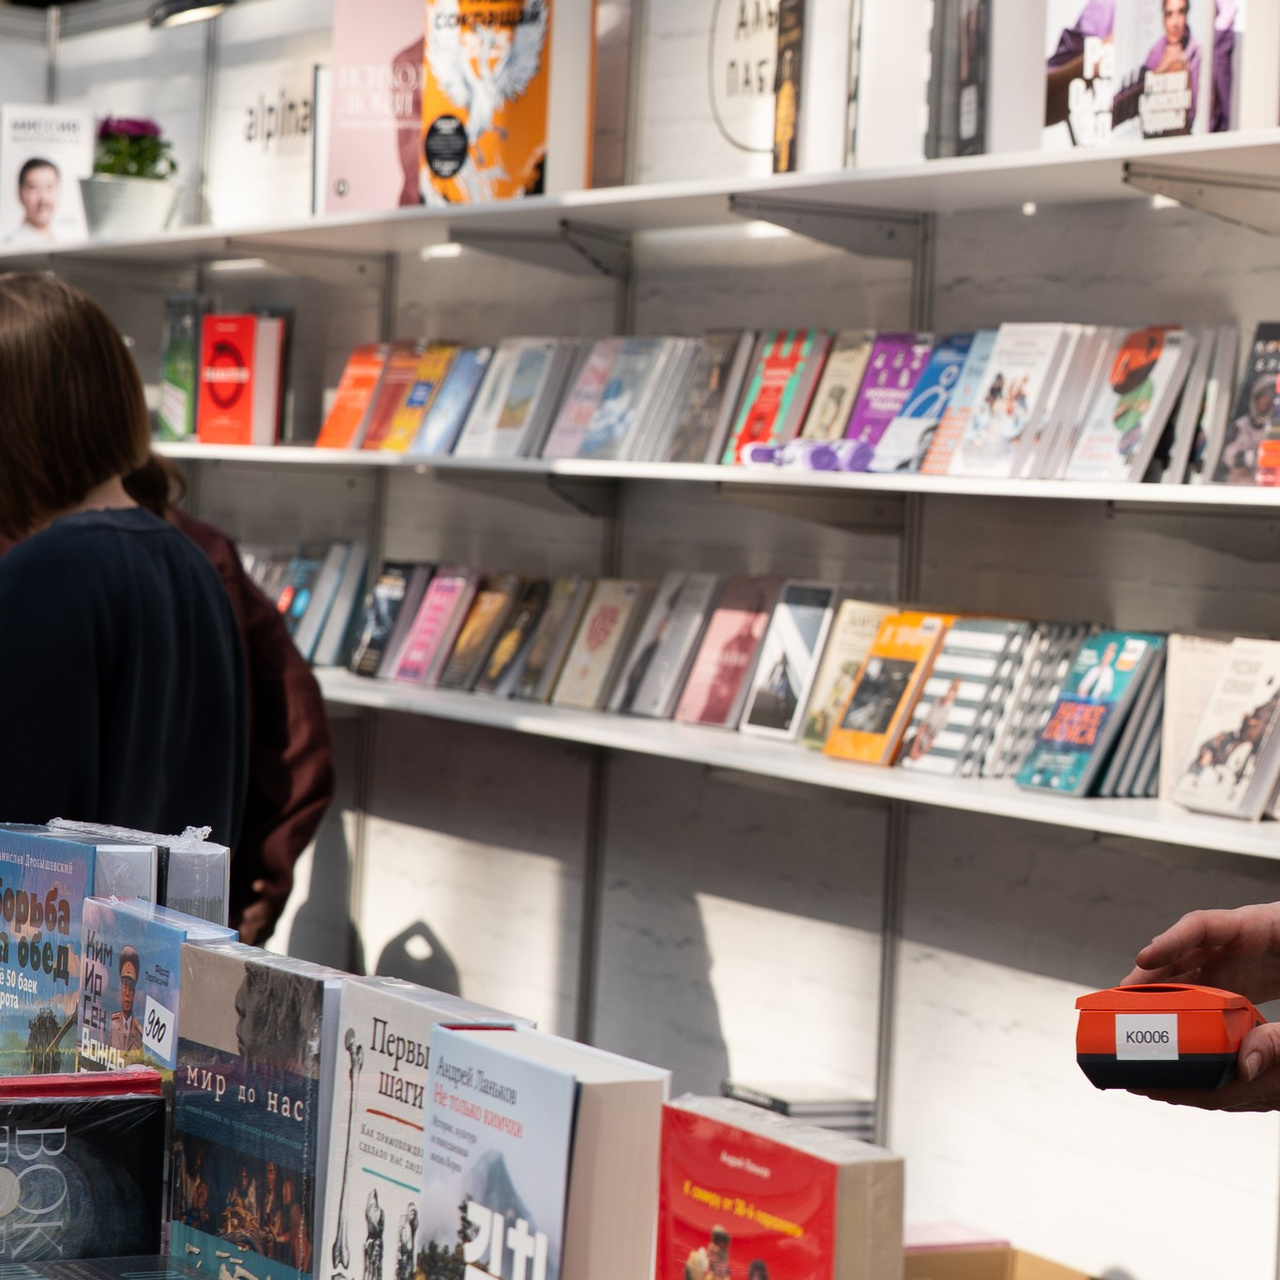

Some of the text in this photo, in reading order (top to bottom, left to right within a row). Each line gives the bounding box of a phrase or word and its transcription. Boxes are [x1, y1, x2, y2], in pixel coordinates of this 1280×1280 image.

[0, 877, 70, 936] орьба
[18, 931, 70, 986] обед
[86, 929, 113, 968] Ким
[7, 970, 38, 995] 50 баек
[84, 962, 103, 1004] Ир
[82, 995, 107, 1032] Сен
[1126, 1030, 1169, 1045] K0006
[186, 1065, 304, 1122] мир до нас
[378, 1071, 425, 1109] шаги
[436, 1055, 518, 1106] Андрей Ланьков
[433, 1081, 449, 1108] Не
[449, 1094, 482, 1122] только
